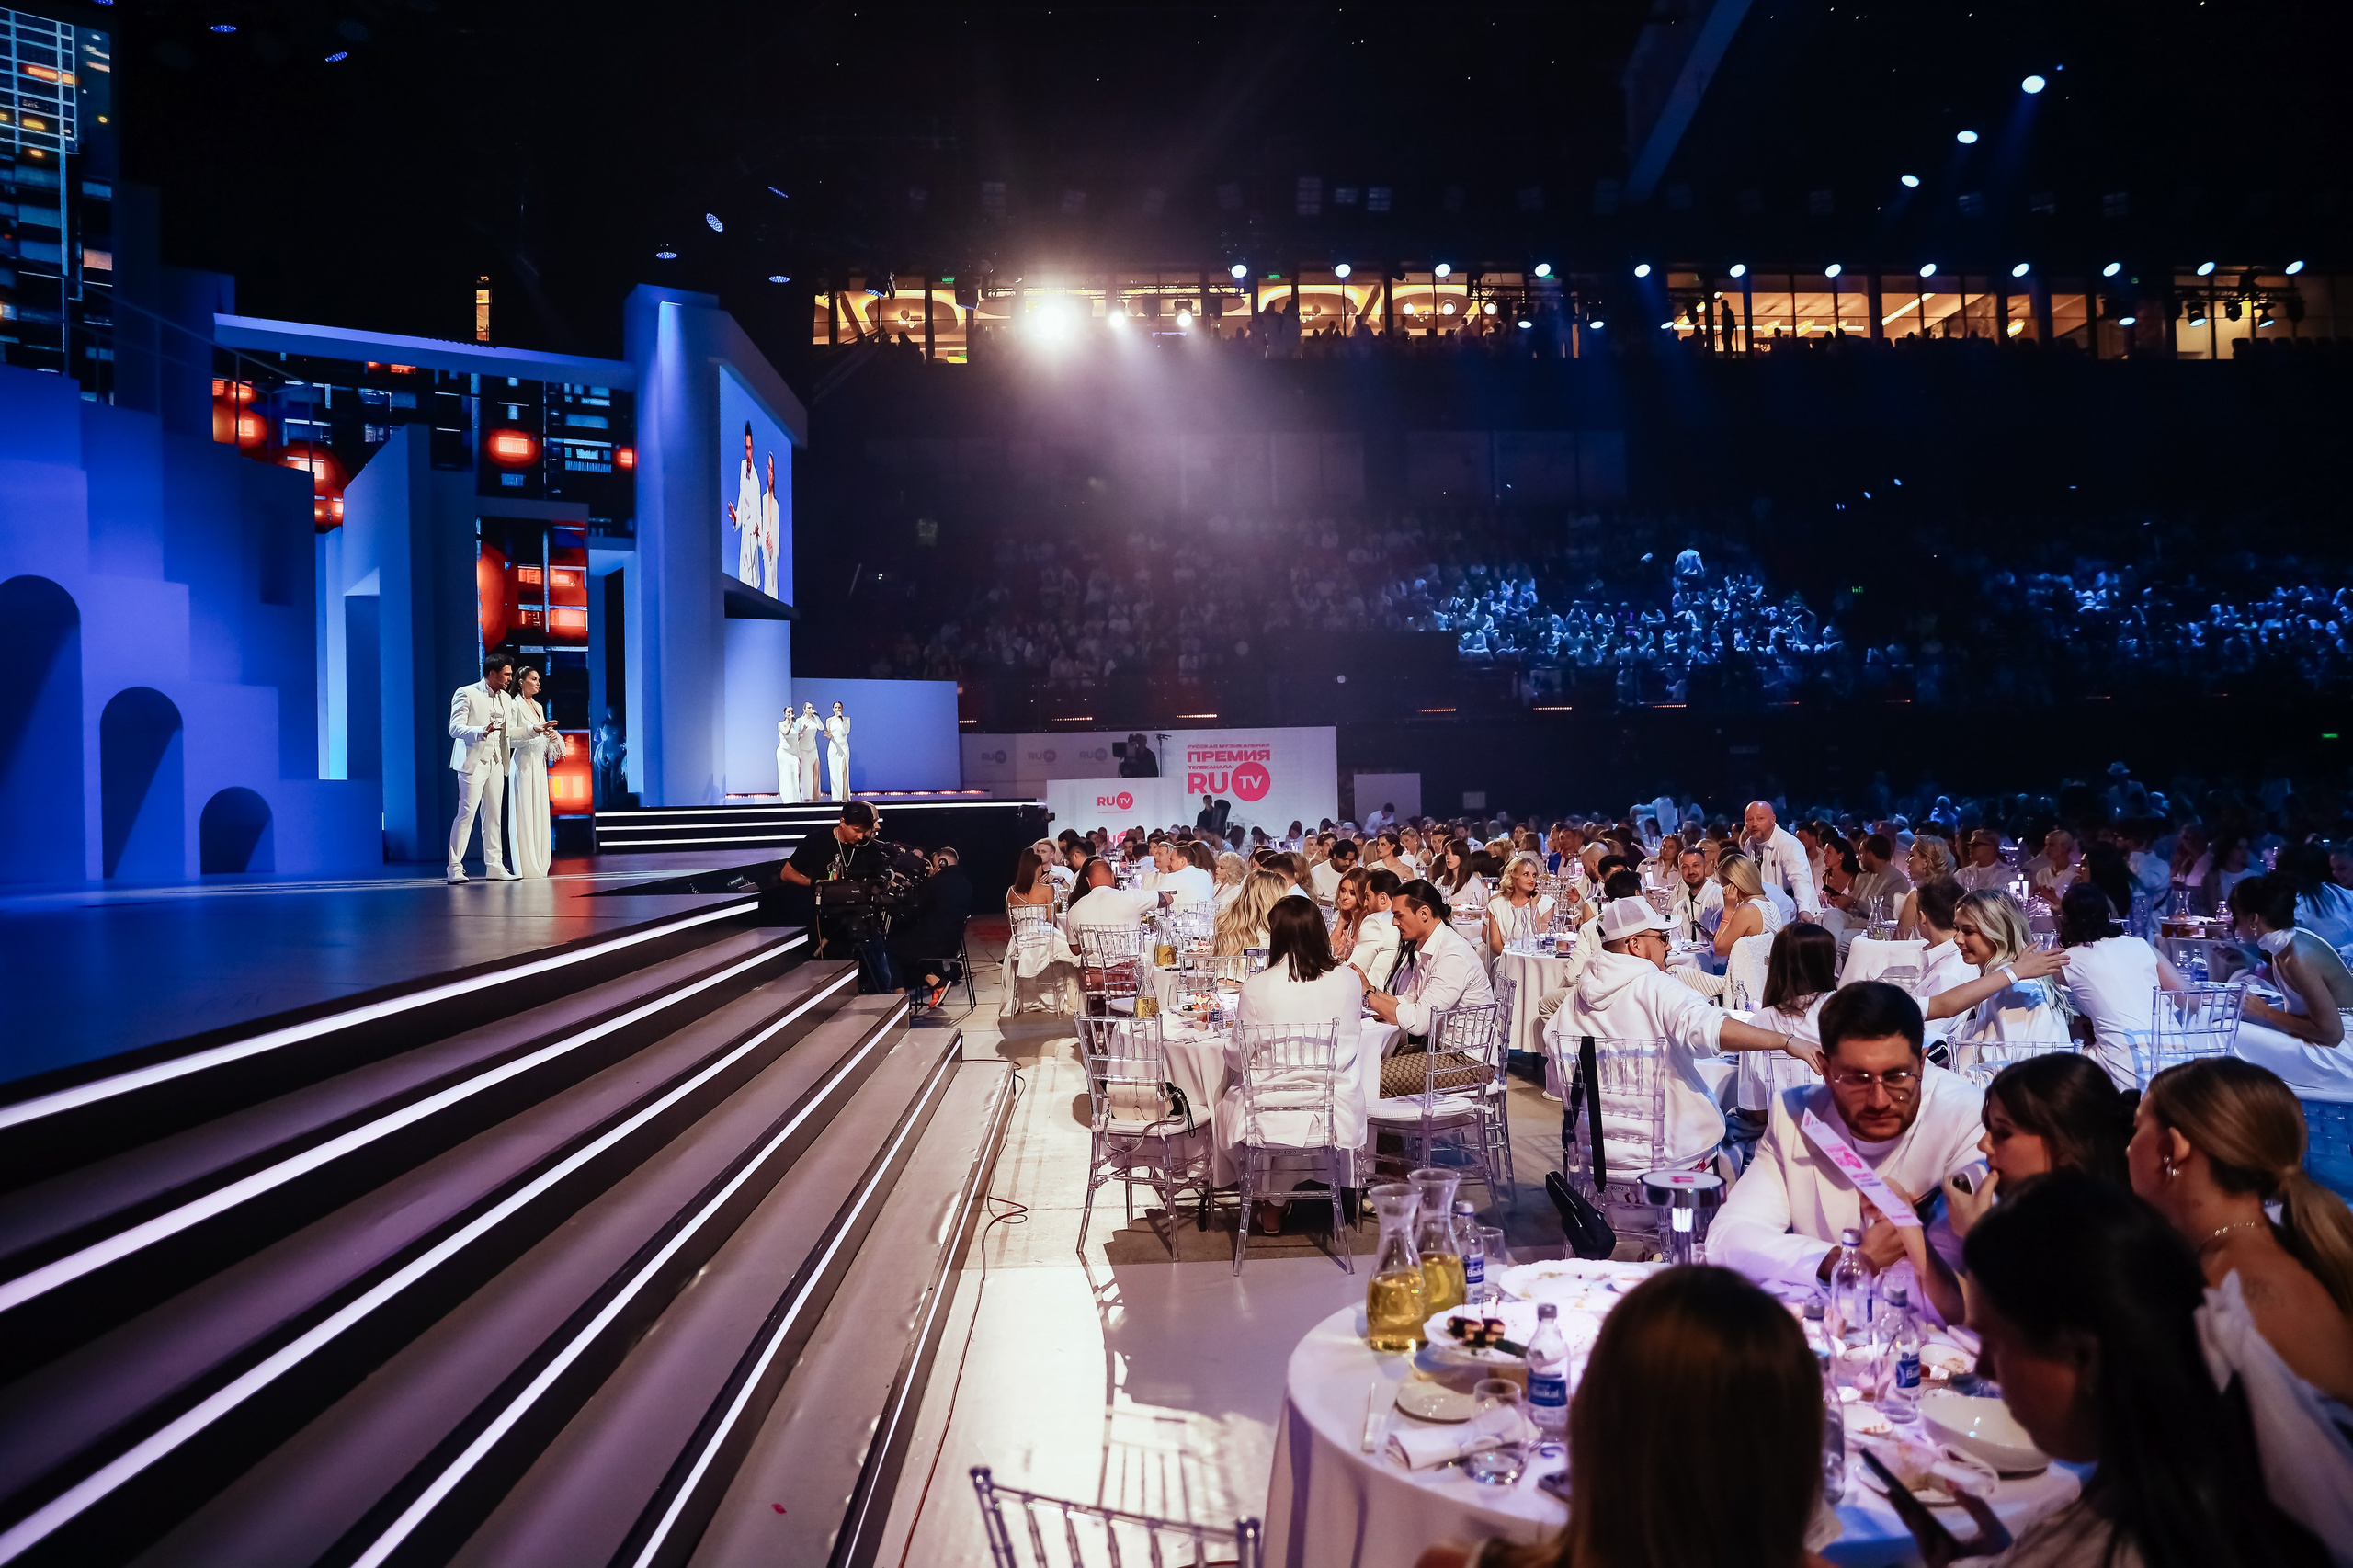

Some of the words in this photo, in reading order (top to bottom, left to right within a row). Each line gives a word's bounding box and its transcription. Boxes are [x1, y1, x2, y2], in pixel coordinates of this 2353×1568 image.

[1187, 750, 1270, 762] ПРЕМИЯ
[1188, 772, 1228, 794] RU
[1238, 775, 1263, 789] TV
[1097, 796, 1115, 806] RU
